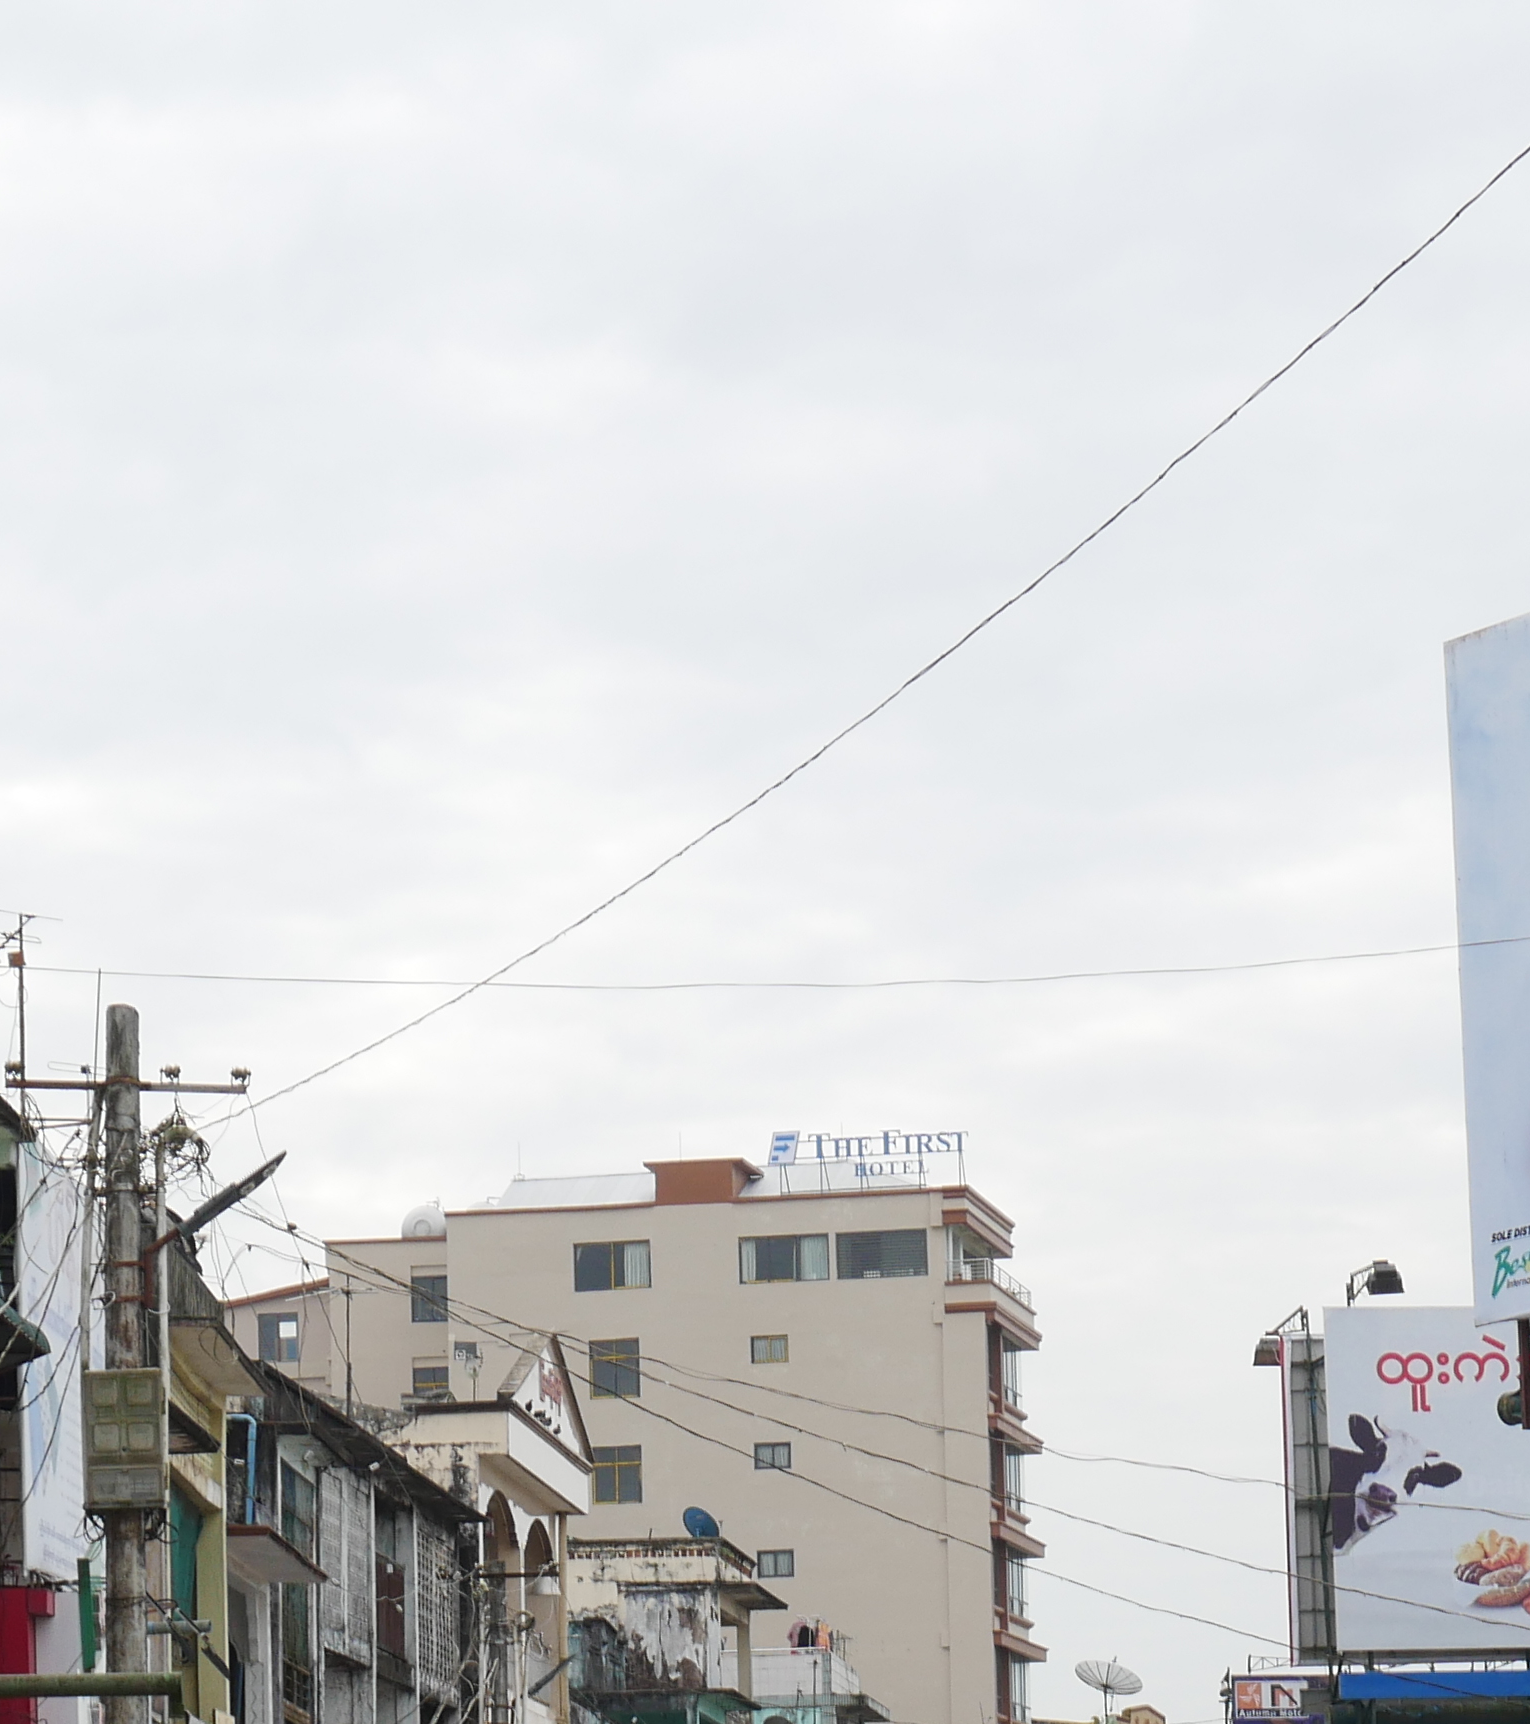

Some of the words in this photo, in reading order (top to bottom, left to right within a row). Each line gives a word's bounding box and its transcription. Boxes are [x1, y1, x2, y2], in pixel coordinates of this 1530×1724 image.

[808, 1132, 873, 1159] THE
[880, 1129, 969, 1155] FIRST
[854, 1160, 930, 1177] HOTEL
[1491, 1229, 1513, 1243] SOLE
[1239, 1708, 1277, 1718] Autumn
